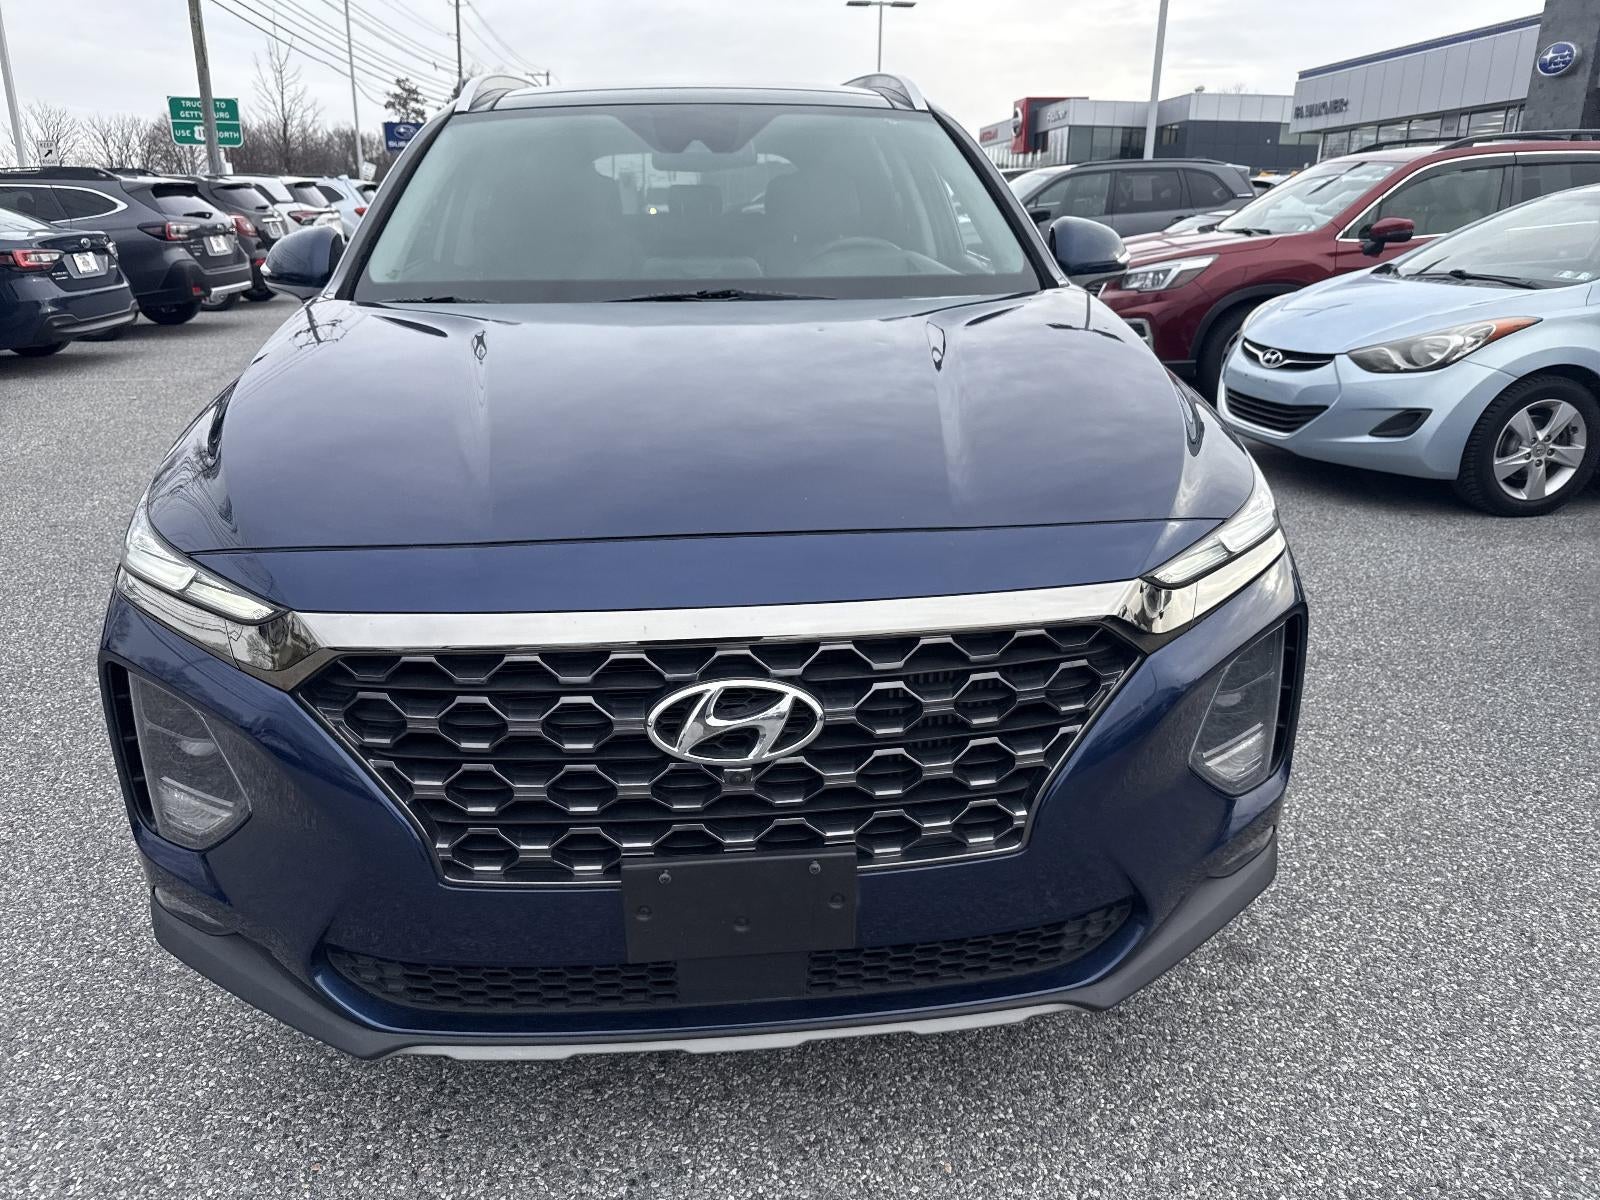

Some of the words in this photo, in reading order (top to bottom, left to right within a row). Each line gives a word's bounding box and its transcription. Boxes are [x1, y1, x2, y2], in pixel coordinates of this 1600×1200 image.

[179, 111, 230, 119] GETTYURG
[175, 129, 191, 137] USE
[216, 129, 239, 139] ORTH
